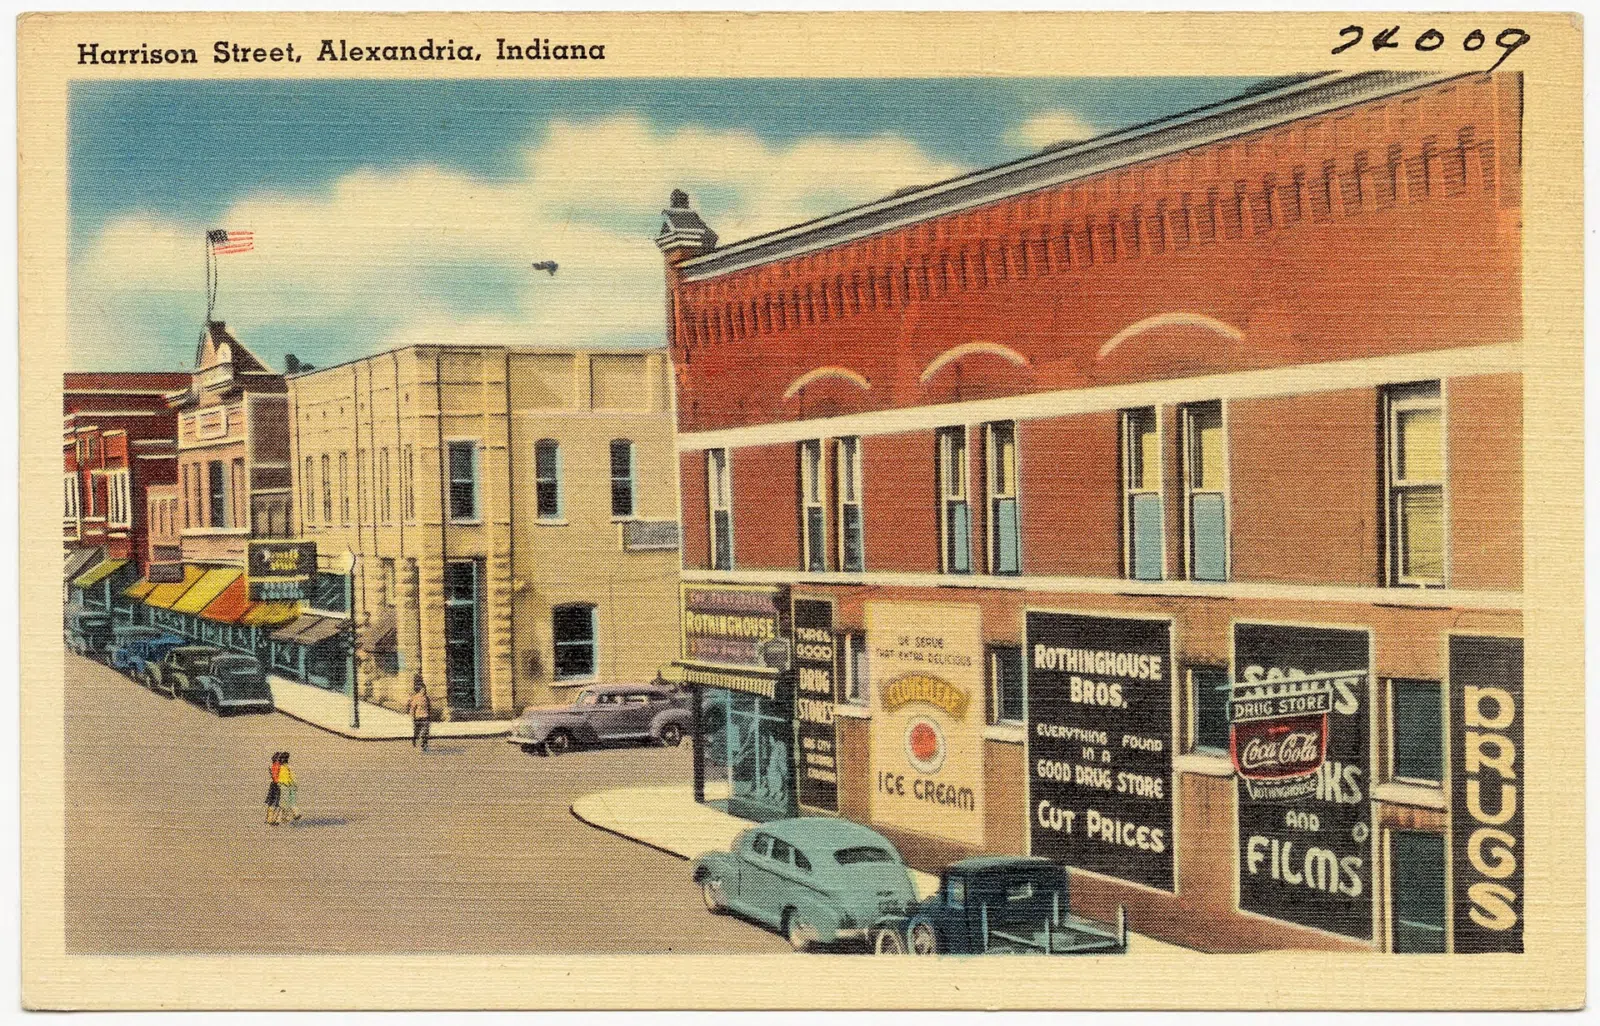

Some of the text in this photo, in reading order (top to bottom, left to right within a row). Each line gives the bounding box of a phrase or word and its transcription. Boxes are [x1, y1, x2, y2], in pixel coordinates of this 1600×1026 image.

[686, 611, 775, 639] ROTHINGHOUSE
[796, 643, 833, 661] GOOD
[915, 636, 944, 649] SERVE
[898, 651, 924, 661] EXTRA
[927, 652, 972, 667] DELICIOUS
[1034, 644, 1162, 680] ROTHINGHOUSE
[799, 667, 831, 694] DRUG
[1070, 676, 1128, 709] BROS.
[798, 698, 834, 724] STORES
[1234, 692, 1326, 719] DRUG STORE
[1037, 723, 1163, 752] EVERYTHING FOUND
[1082, 746, 1111, 763] IN A
[878, 770, 975, 812] ICE CREAM
[1037, 759, 1164, 799] GOOD DRUG STORE
[1285, 810, 1320, 831] AND
[1464, 685, 1518, 931] DRUGS
[1038, 799, 1165, 853] CUT PRICES
[1247, 834, 1363, 897] FILMS
